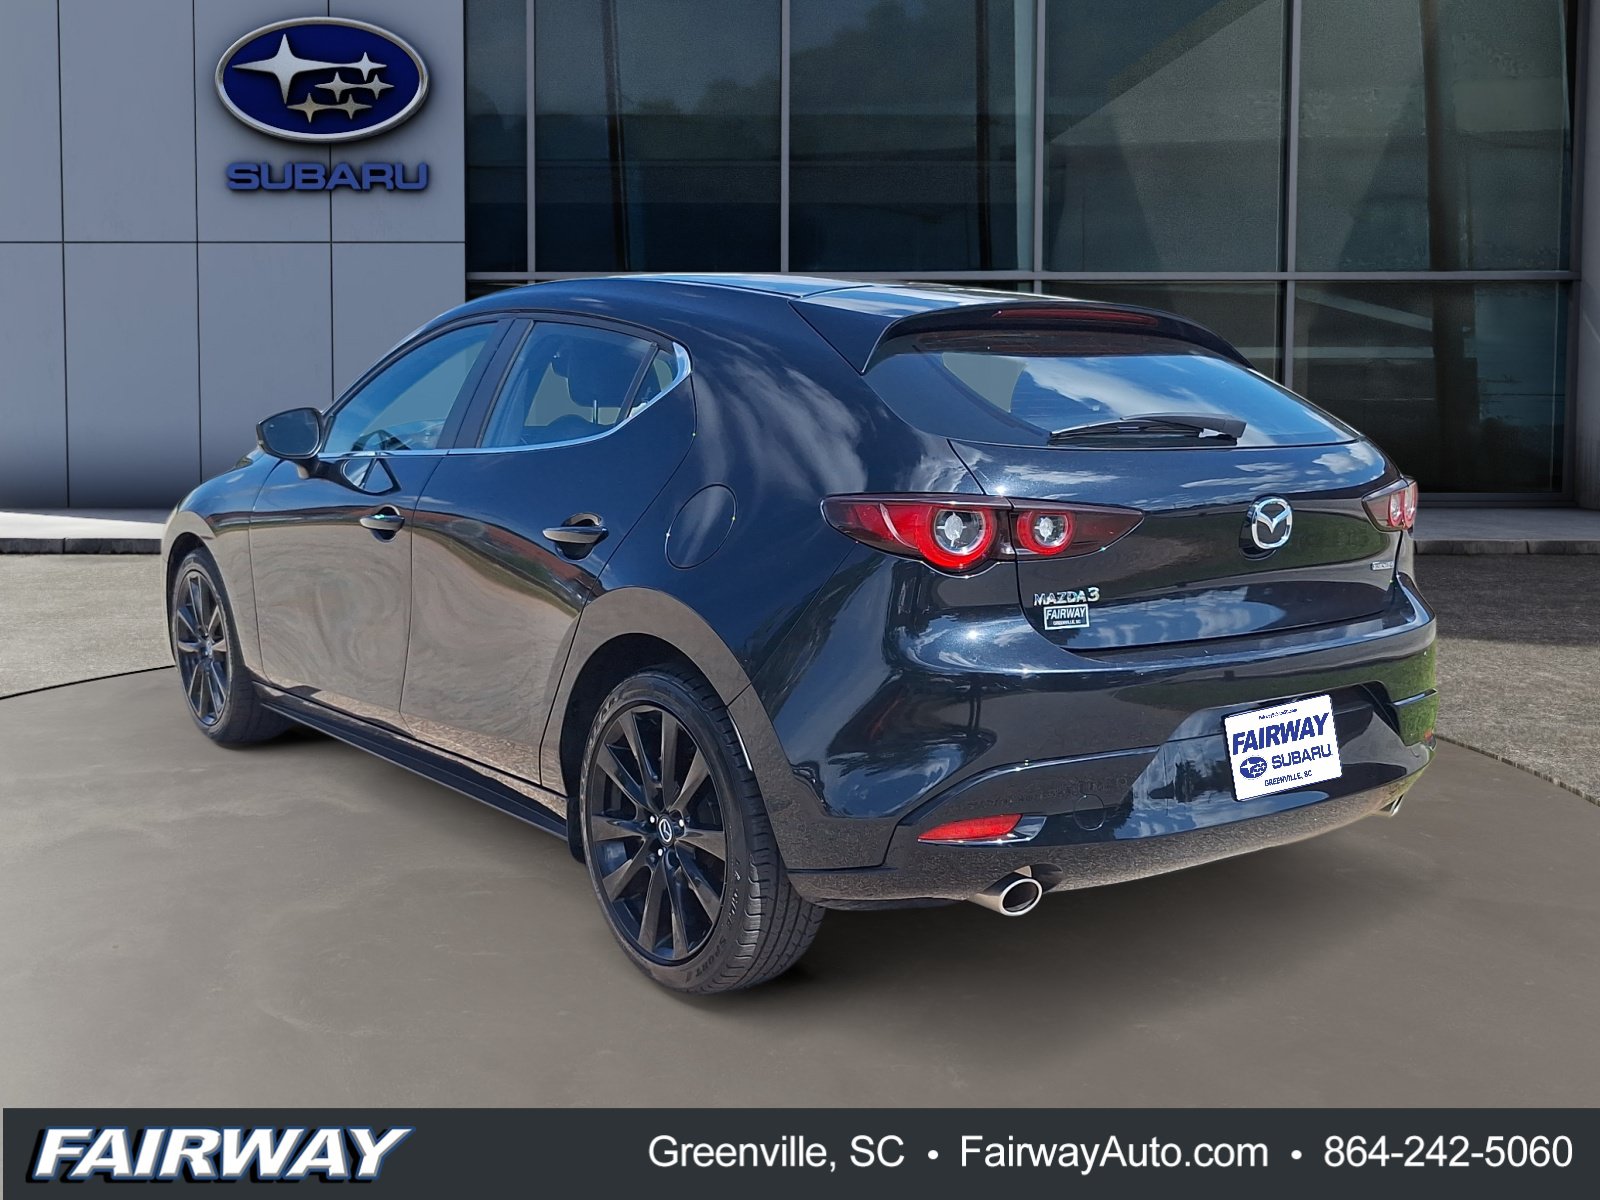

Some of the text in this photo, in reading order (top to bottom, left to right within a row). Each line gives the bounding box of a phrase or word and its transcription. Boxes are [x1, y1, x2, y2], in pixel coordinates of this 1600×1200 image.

[226, 161, 429, 191] SUBARU
[1034, 586, 1100, 606] MAZDA3
[1046, 607, 1086, 620] FAIRWAY
[1232, 712, 1329, 755] FAIRWAY
[1271, 743, 1333, 769] SUBARU
